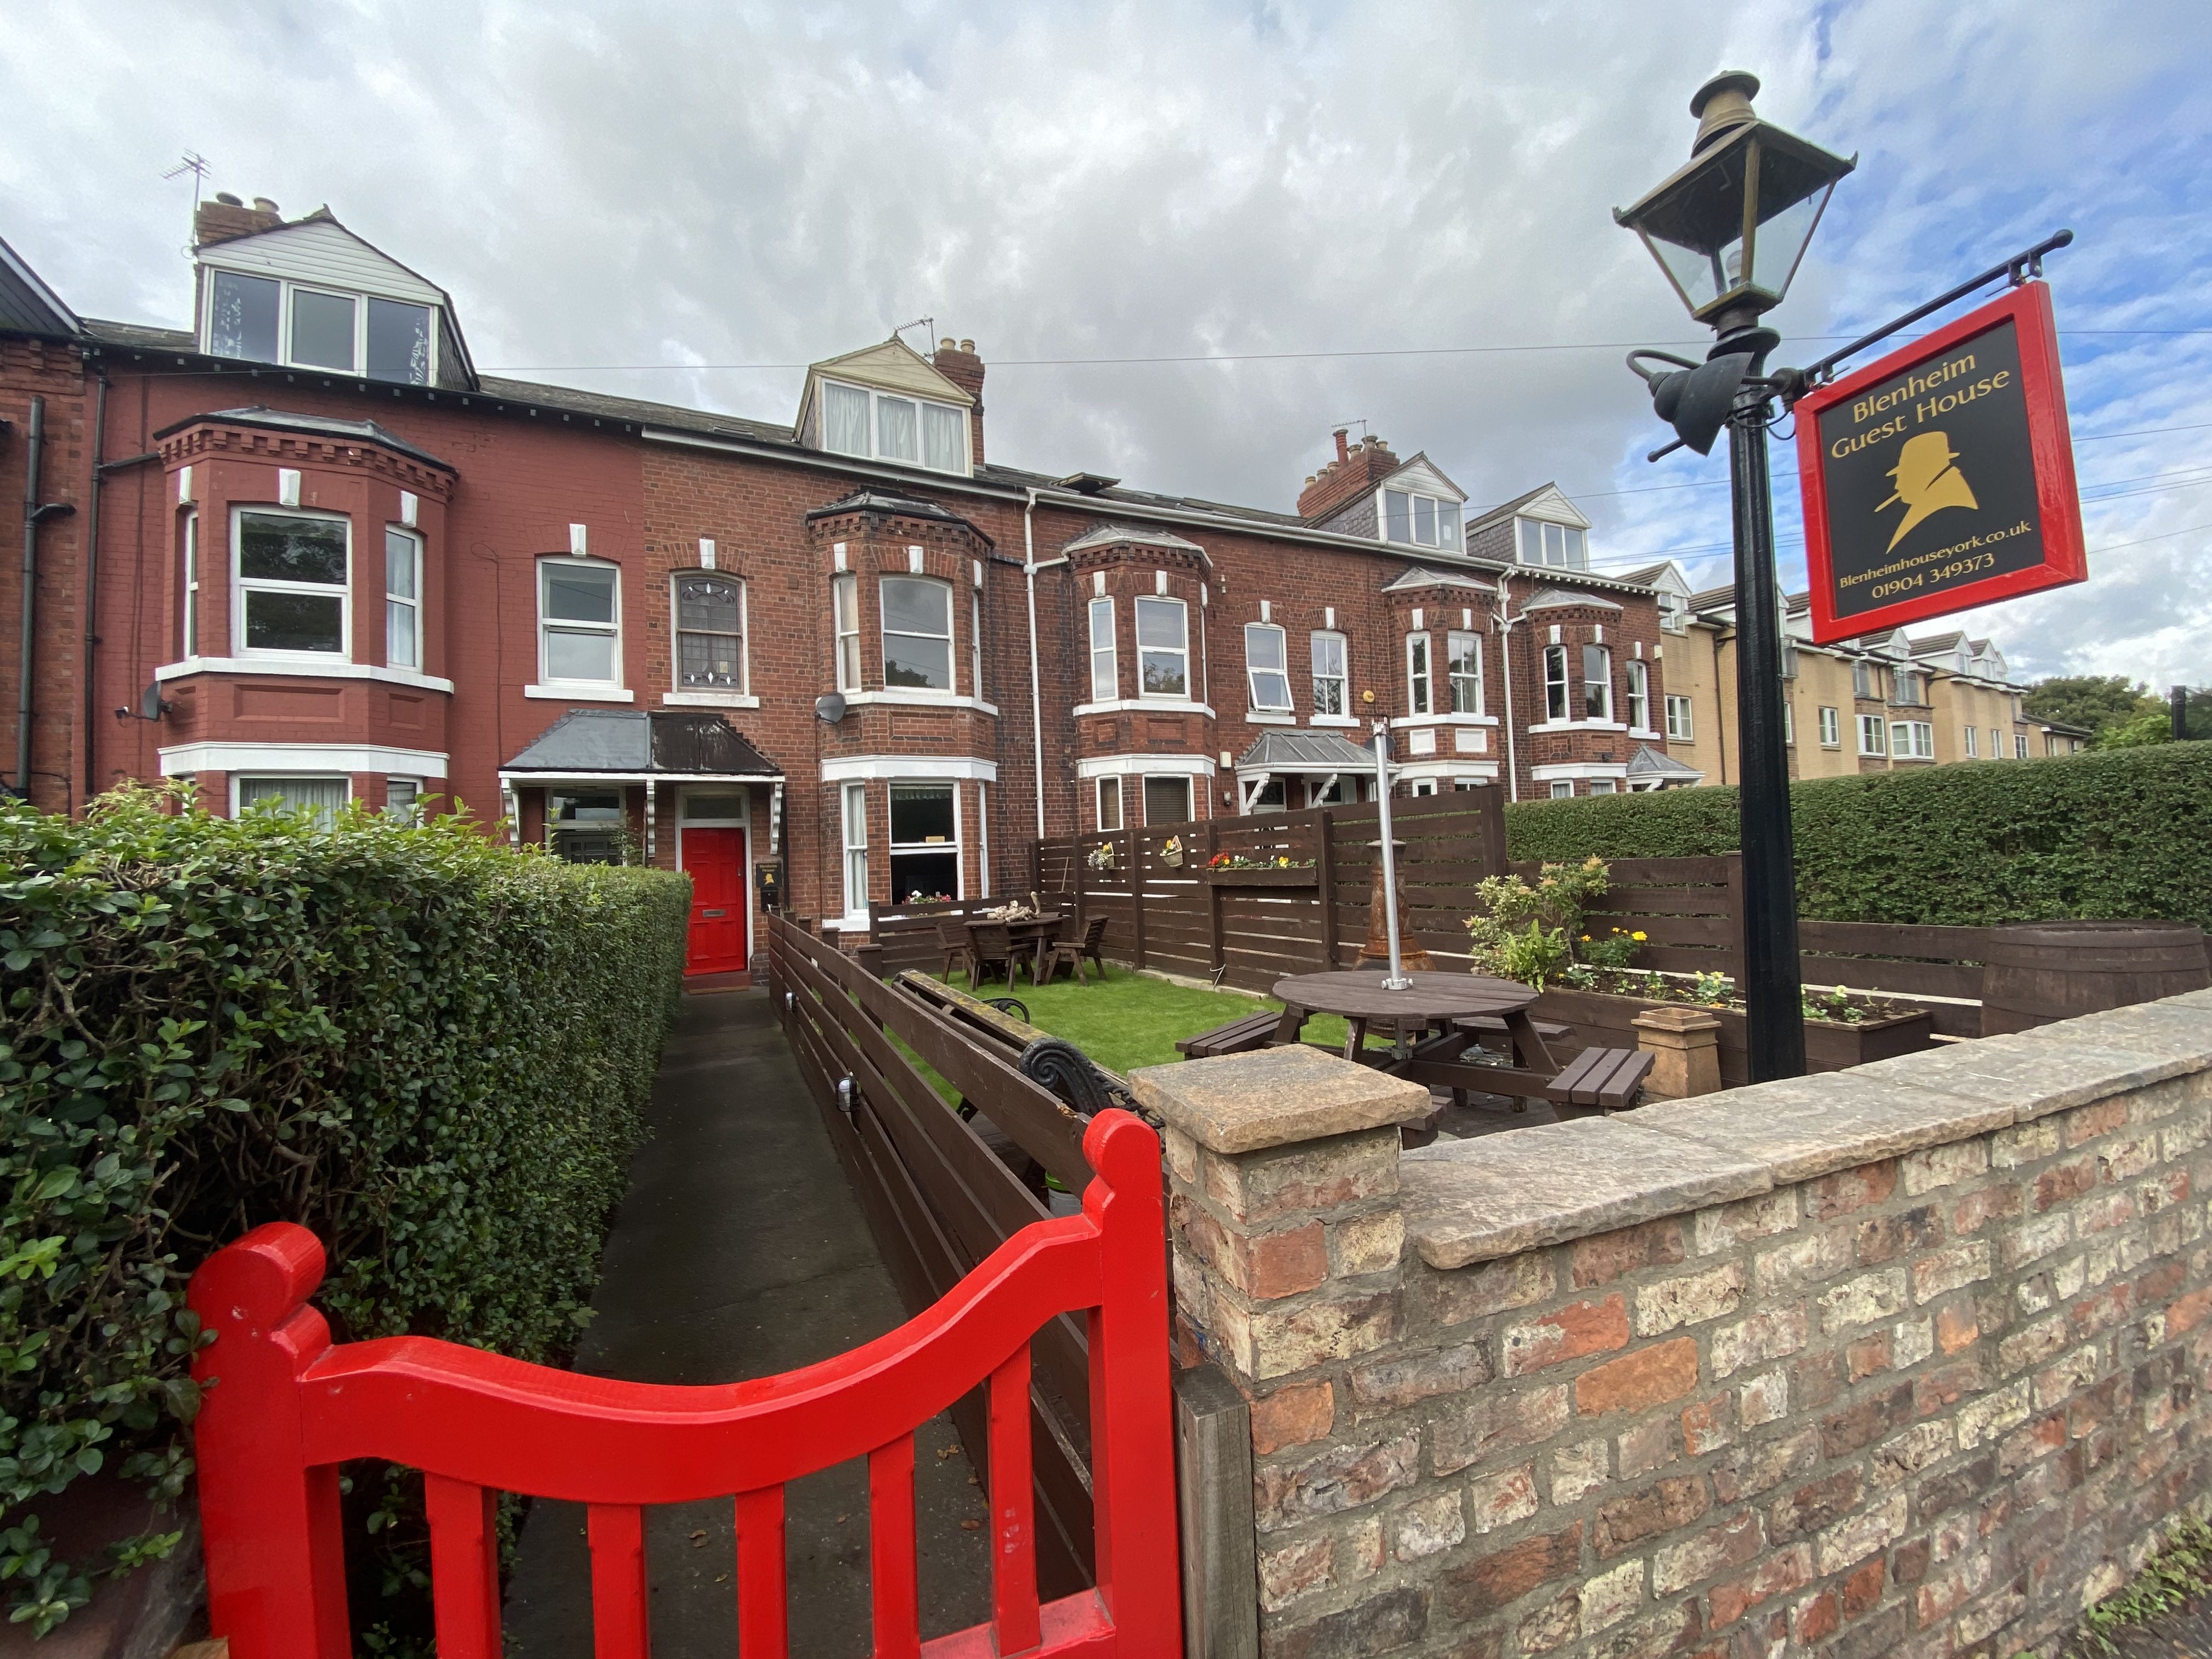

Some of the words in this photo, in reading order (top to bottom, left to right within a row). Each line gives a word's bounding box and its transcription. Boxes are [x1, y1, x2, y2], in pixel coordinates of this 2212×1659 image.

[1831, 414, 1907, 459] Guest
[1916, 370, 2010, 423] House
[1853, 354, 1976, 423] Blenheim
[1839, 521, 2032, 589] Blenheimhouseyork.co.uk
[1871, 573, 1924, 599] 01904
[1929, 552, 1995, 583] 349373
